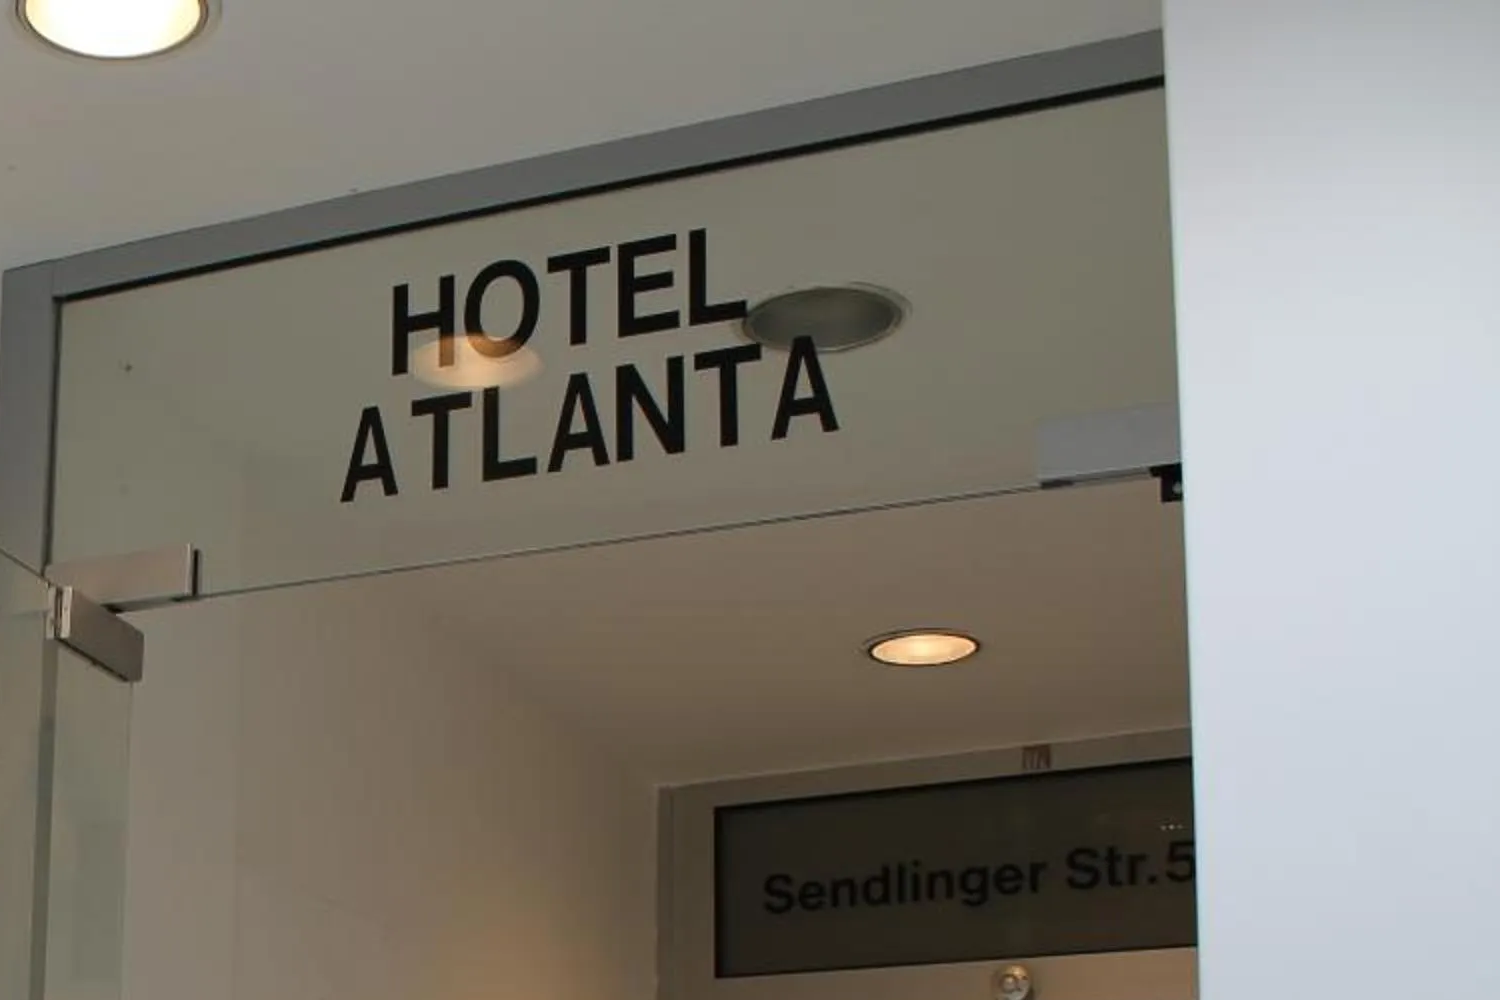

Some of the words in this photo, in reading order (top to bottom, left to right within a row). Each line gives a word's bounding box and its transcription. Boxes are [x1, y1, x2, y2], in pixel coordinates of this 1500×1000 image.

[391, 228, 747, 376] HOTEL
[340, 335, 840, 503] ATLANTA
[763, 858, 1047, 914] Sendlinger
